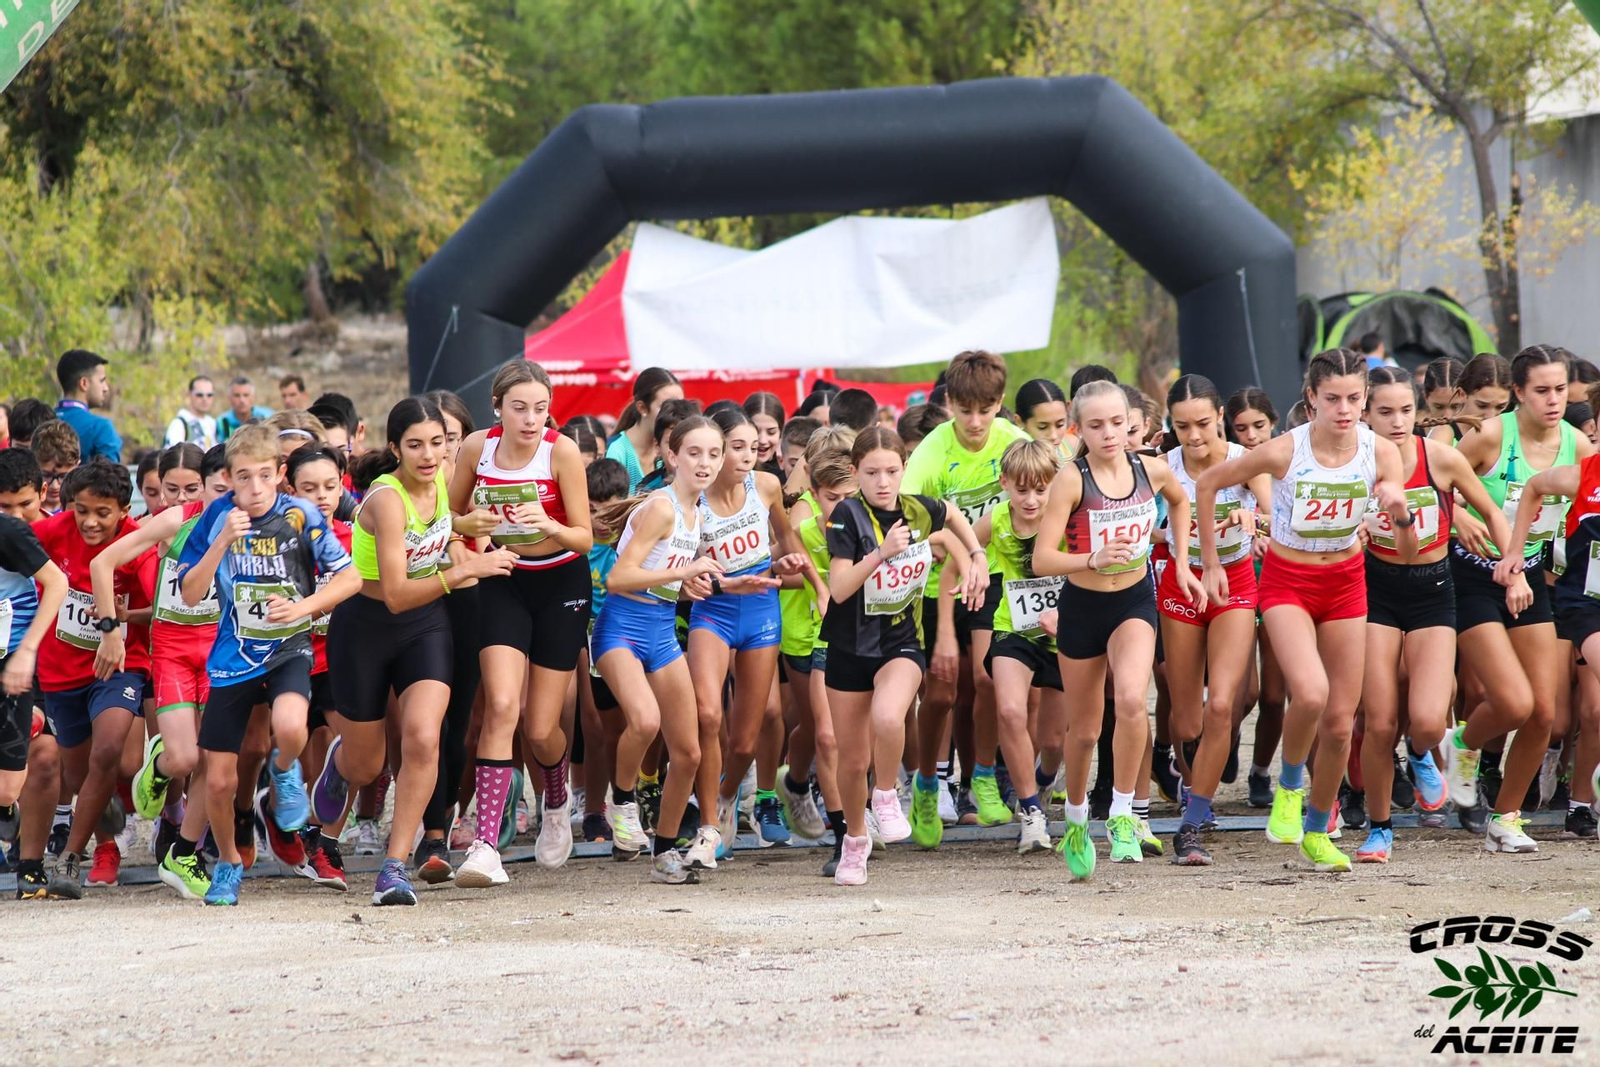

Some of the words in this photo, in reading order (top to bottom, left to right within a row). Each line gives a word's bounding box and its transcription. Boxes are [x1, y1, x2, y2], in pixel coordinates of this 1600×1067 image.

[1304, 498, 1354, 521] 241
[705, 529, 760, 562] 1100
[871, 561, 925, 590] 1399
